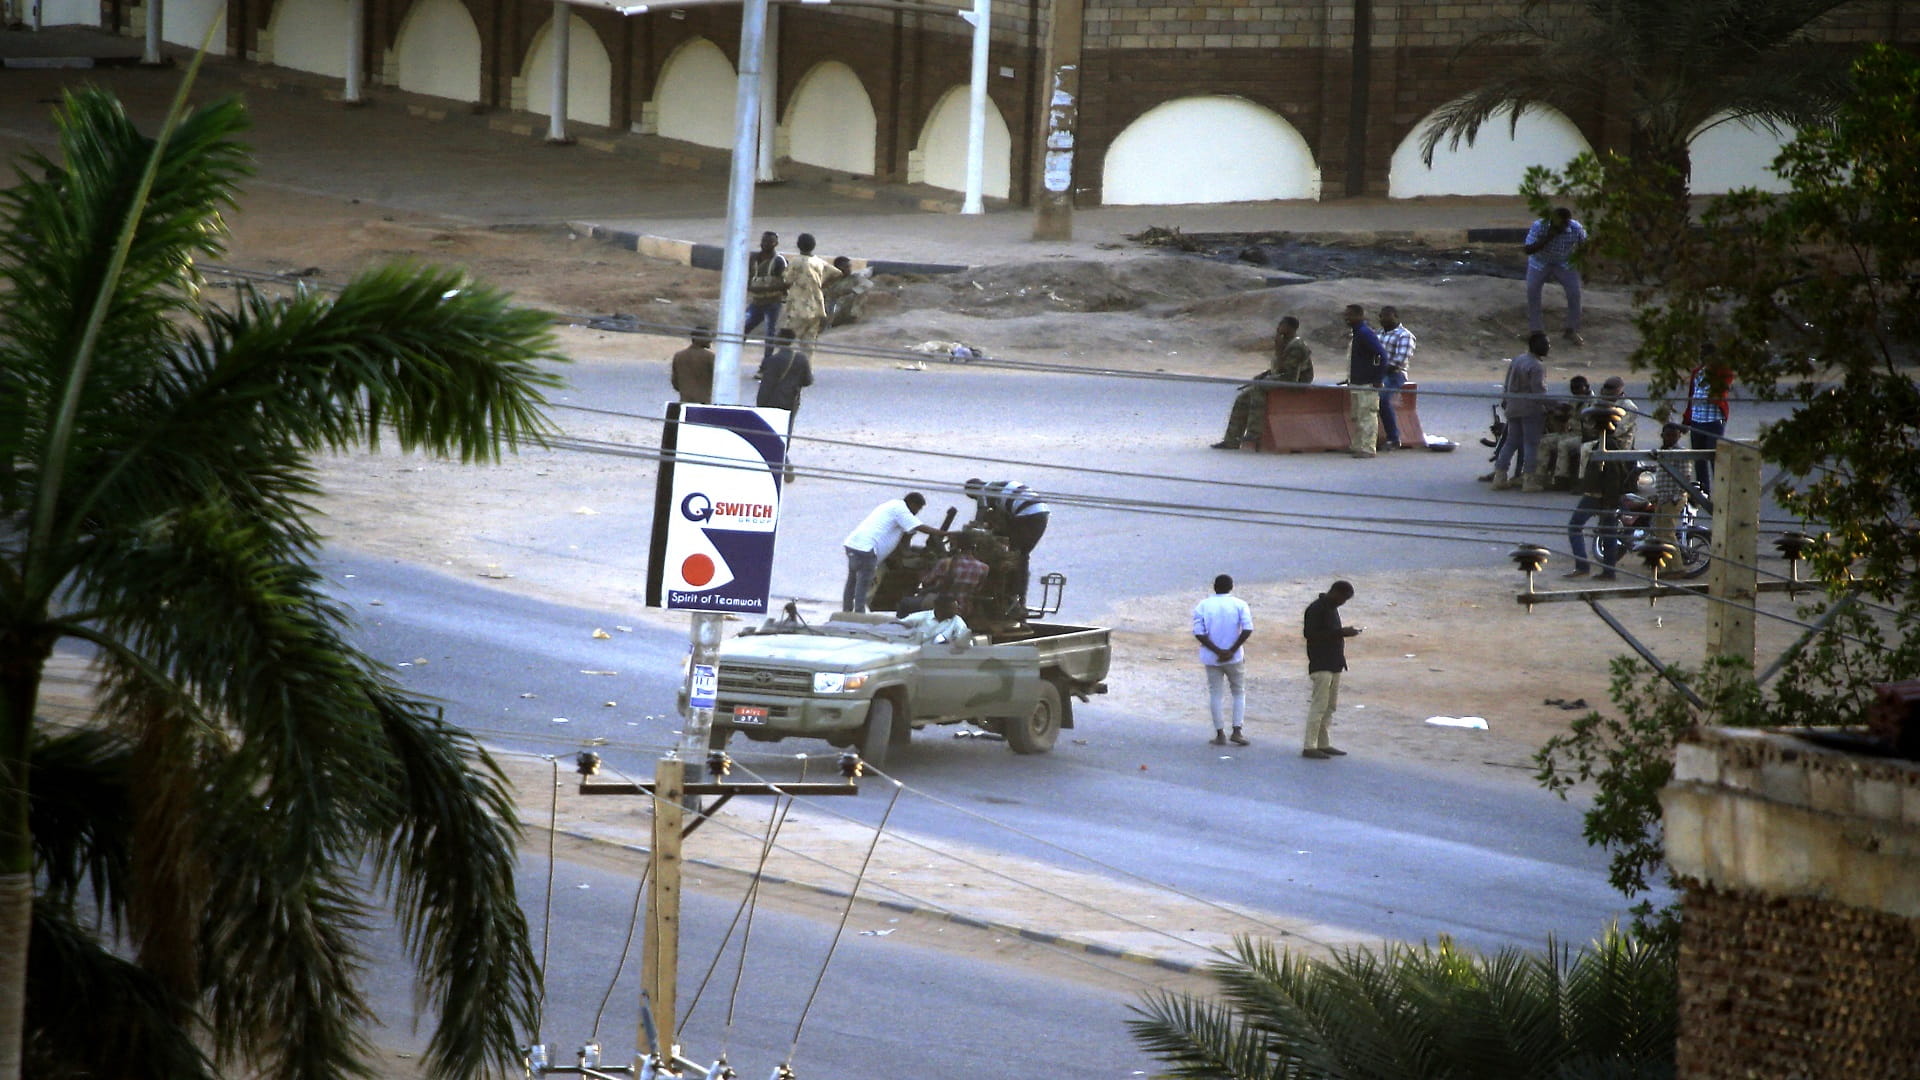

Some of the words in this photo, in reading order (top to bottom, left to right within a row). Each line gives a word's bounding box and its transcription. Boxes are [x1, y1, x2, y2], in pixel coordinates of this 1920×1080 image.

[715, 502, 772, 518] SWITCH
[671, 592, 698, 603] Spirit
[700, 594, 712, 604] of
[714, 594, 762, 607] Teamwork
